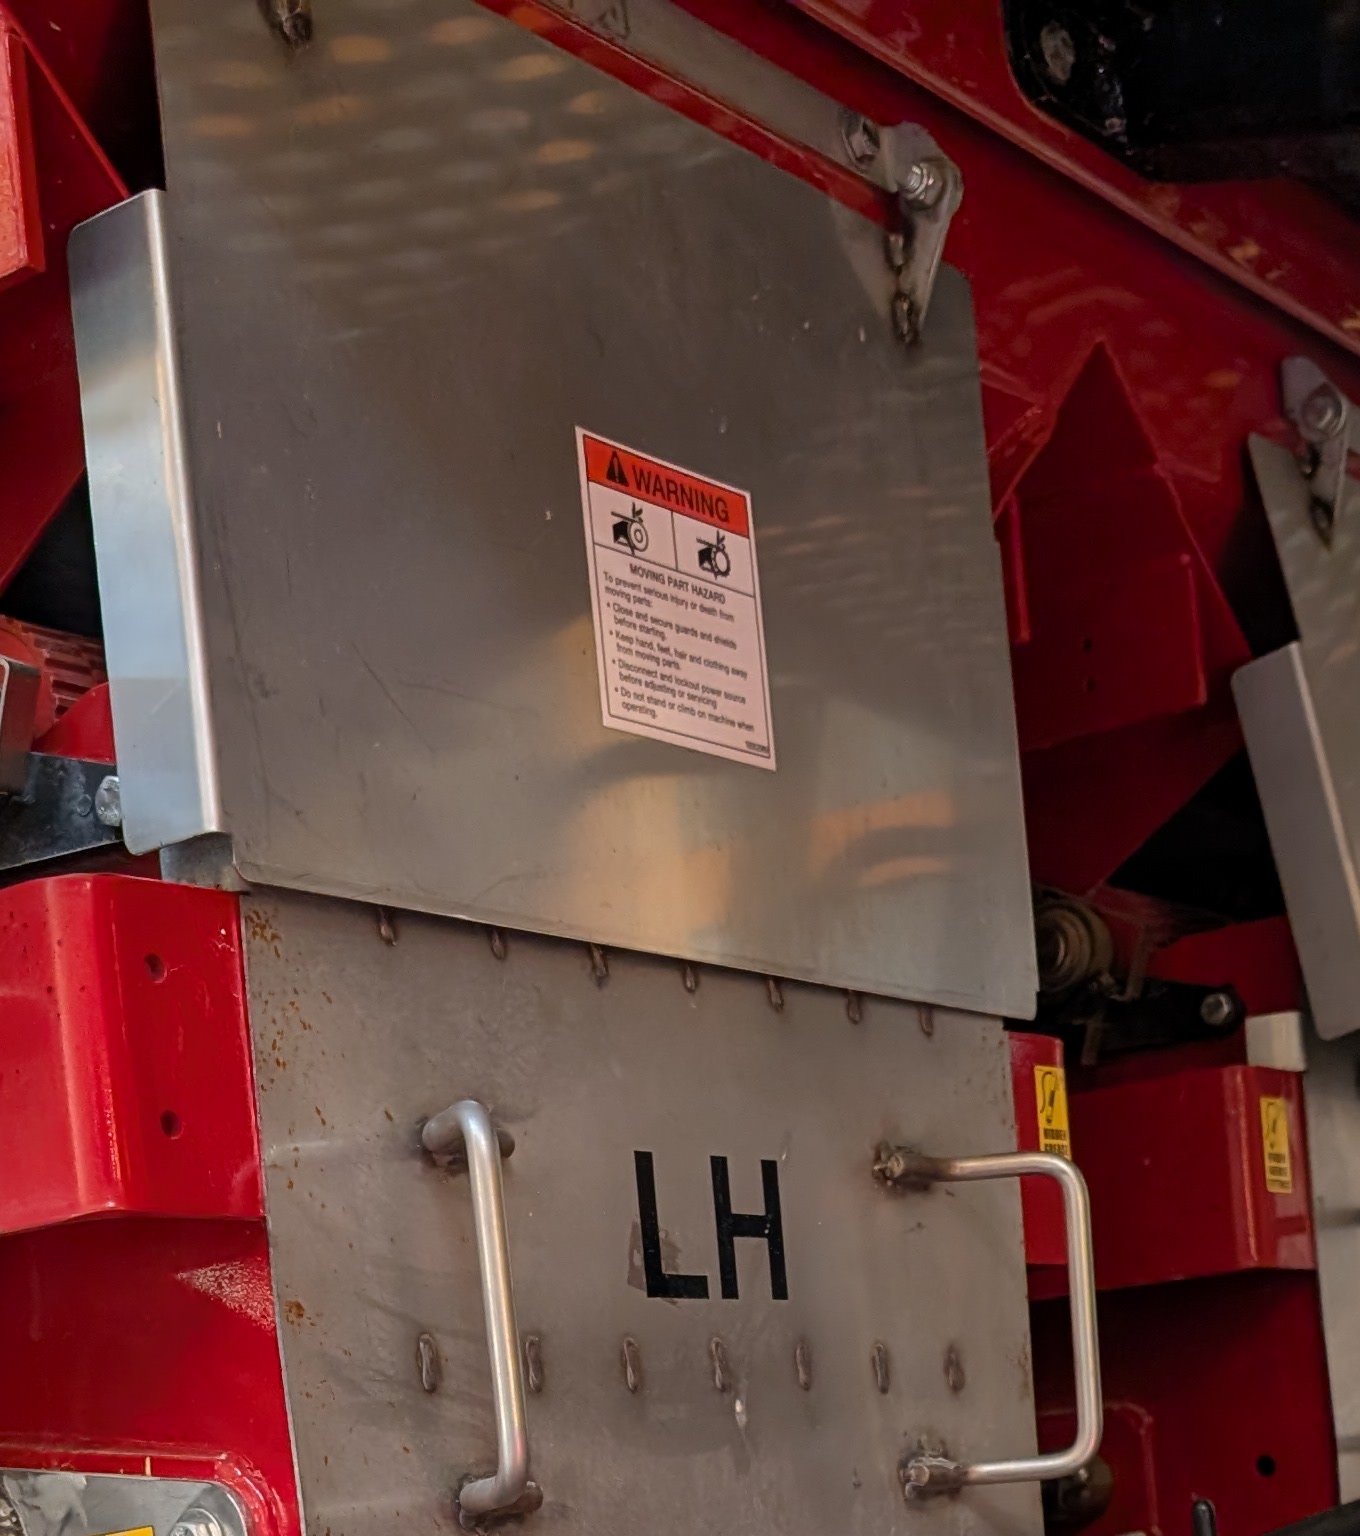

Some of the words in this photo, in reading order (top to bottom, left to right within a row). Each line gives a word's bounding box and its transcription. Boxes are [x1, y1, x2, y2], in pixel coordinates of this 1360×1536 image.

[632, 465, 730, 523] WARNING
[603, 570, 613, 583] To
[614, 575, 641, 593] prevent
[643, 585, 668, 601] serious
[670, 593, 688, 610] injury
[604, 585, 631, 603] moving
[629, 562, 665, 585] MOVING
[667, 575, 689, 592] PART
[691, 583, 726, 605] HAZARD
[612, 601, 632, 617] Close
[635, 609, 648, 622] and
[649, 614, 673, 630] secure
[674, 621, 698, 640] guards
[699, 629, 712, 642] and
[613, 614, 636, 630] before
[615, 628, 633, 645] Keep
[688, 652, 701, 664] and
[616, 642, 633, 655] from
[634, 648, 660, 667] moving
[618, 658, 657, 679] Disconnect
[659, 670, 673, 683] and
[619, 671, 642, 687] before
[644, 678, 676, 698] adjusting
[620, 685, 631, 698] Do
[633, 689, 644, 702] not
[646, 693, 666, 708] stand
[634, 1150, 788, 1300] LH
